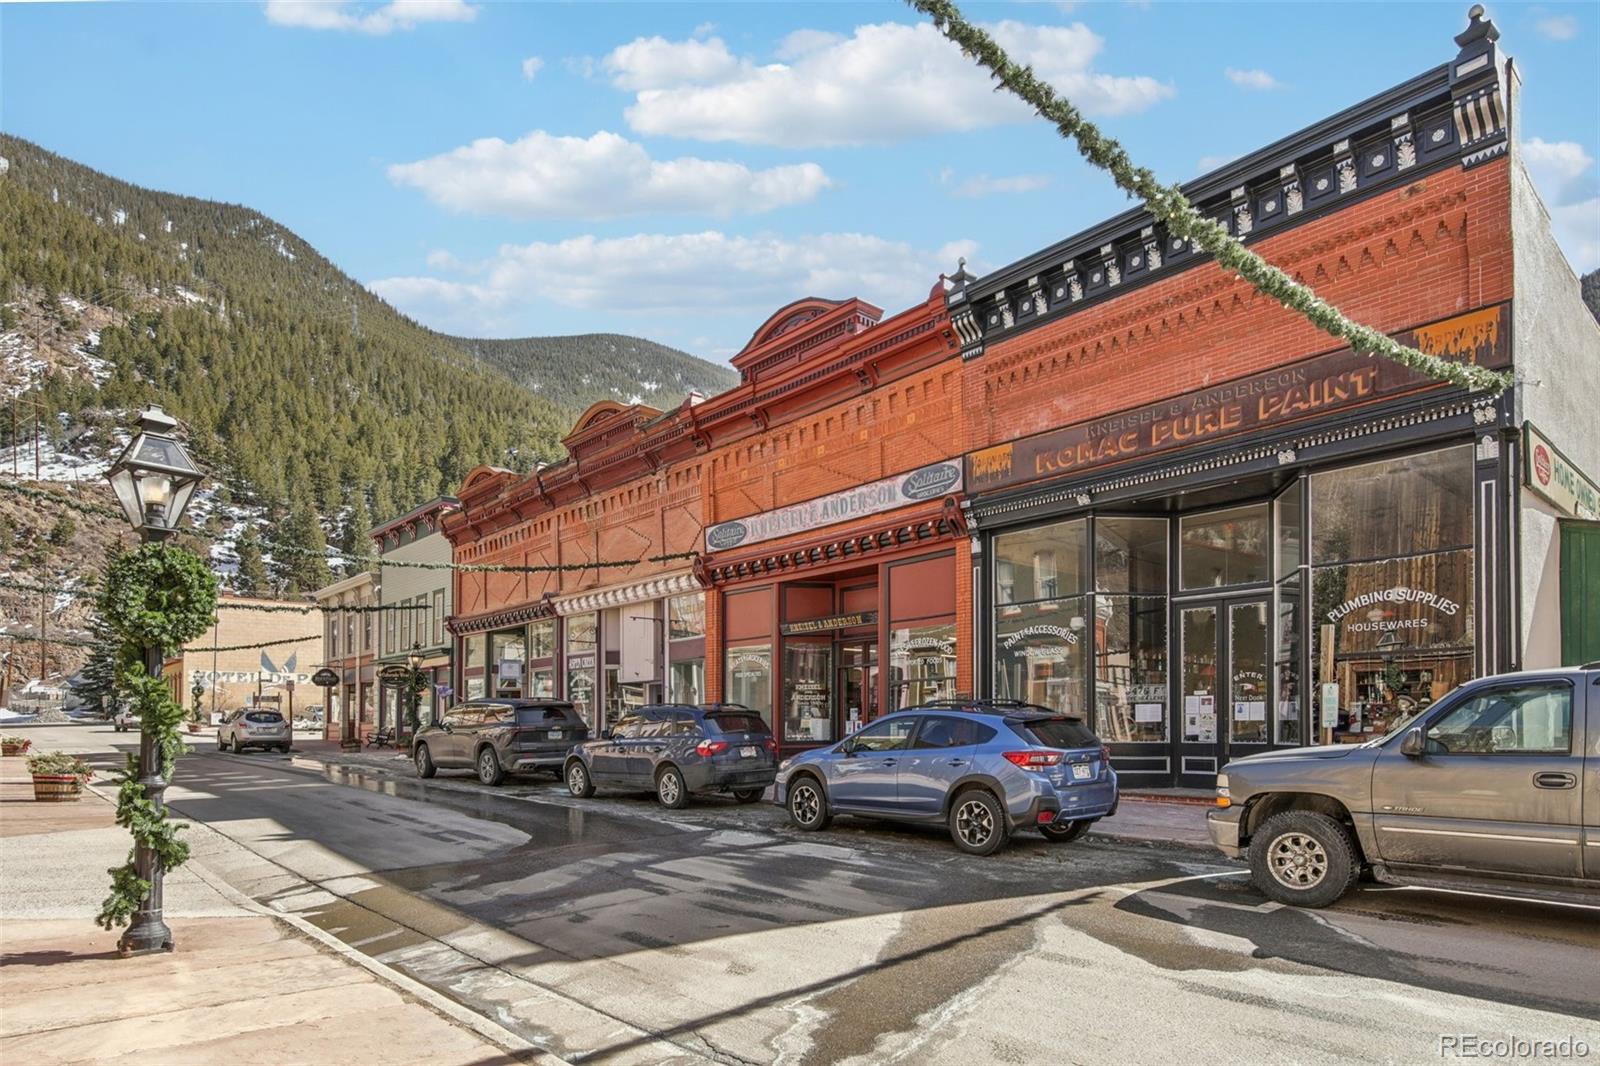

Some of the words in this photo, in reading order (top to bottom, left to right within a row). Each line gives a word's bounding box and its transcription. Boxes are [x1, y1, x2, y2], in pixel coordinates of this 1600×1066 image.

[1086, 408, 1164, 440] KNEISEL
[1170, 401, 1183, 416] &
[1191, 367, 1306, 410] ANDERSON
[1036, 432, 1139, 474] KOMAC
[1151, 404, 1243, 447] PURE
[1257, 363, 1378, 421] PAINT
[908, 467, 957, 492] Solitaire
[750, 507, 808, 537] KNEISEL
[822, 483, 897, 519] ANDERSON
[1327, 589, 1394, 623] PLUMBING
[1396, 588, 1460, 616] SUPPLIES
[789, 620, 817, 633] KNEISEL
[823, 614, 863, 629] ANDERSON
[1347, 618, 1428, 633] HOUSEWARES
[937, 640, 953, 655] FOOD
[1004, 630, 1024, 650] PAINT
[1029, 625, 1078, 645] ACCESSORIES
[1233, 670, 1264, 682] ENTER
